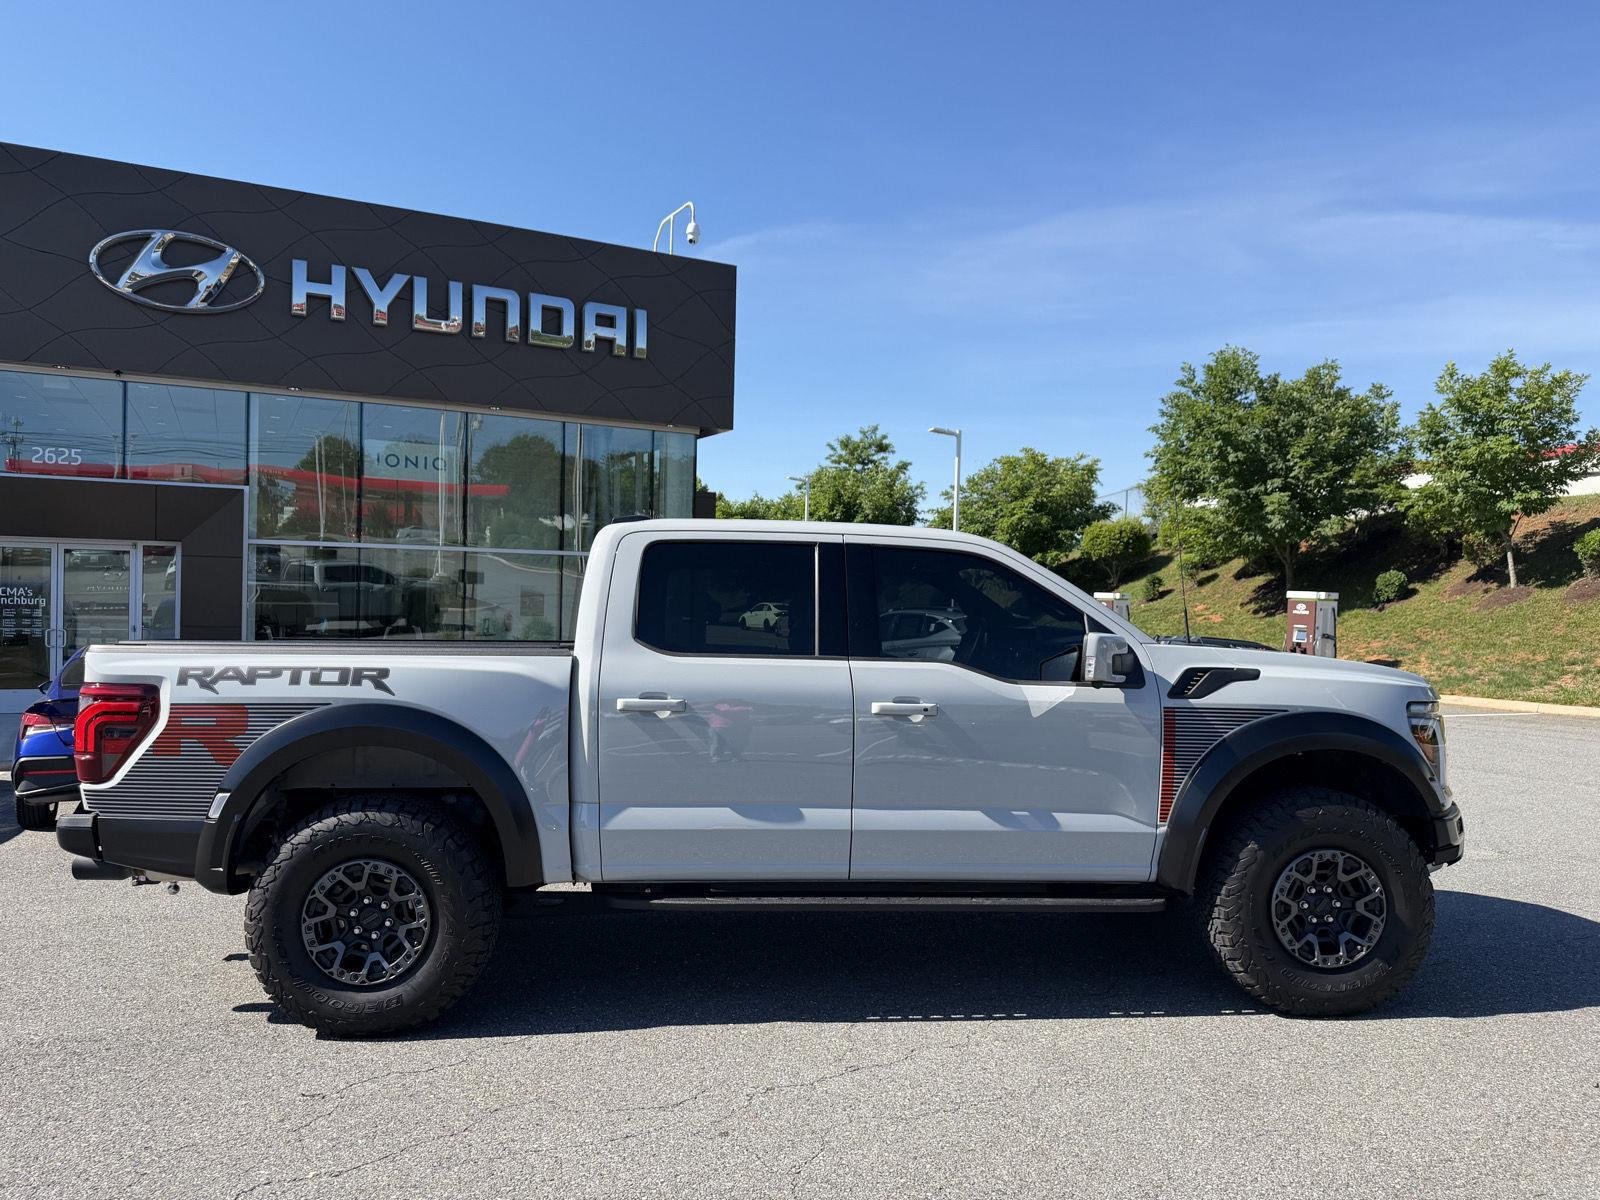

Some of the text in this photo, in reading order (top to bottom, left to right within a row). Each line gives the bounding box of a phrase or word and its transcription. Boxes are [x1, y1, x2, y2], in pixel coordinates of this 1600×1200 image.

[291, 259, 647, 359] HYUNDAI
[31, 446, 82, 466] 2625
[376, 453, 447, 471] IONIQ
[176, 666, 396, 696] RAPTOR
